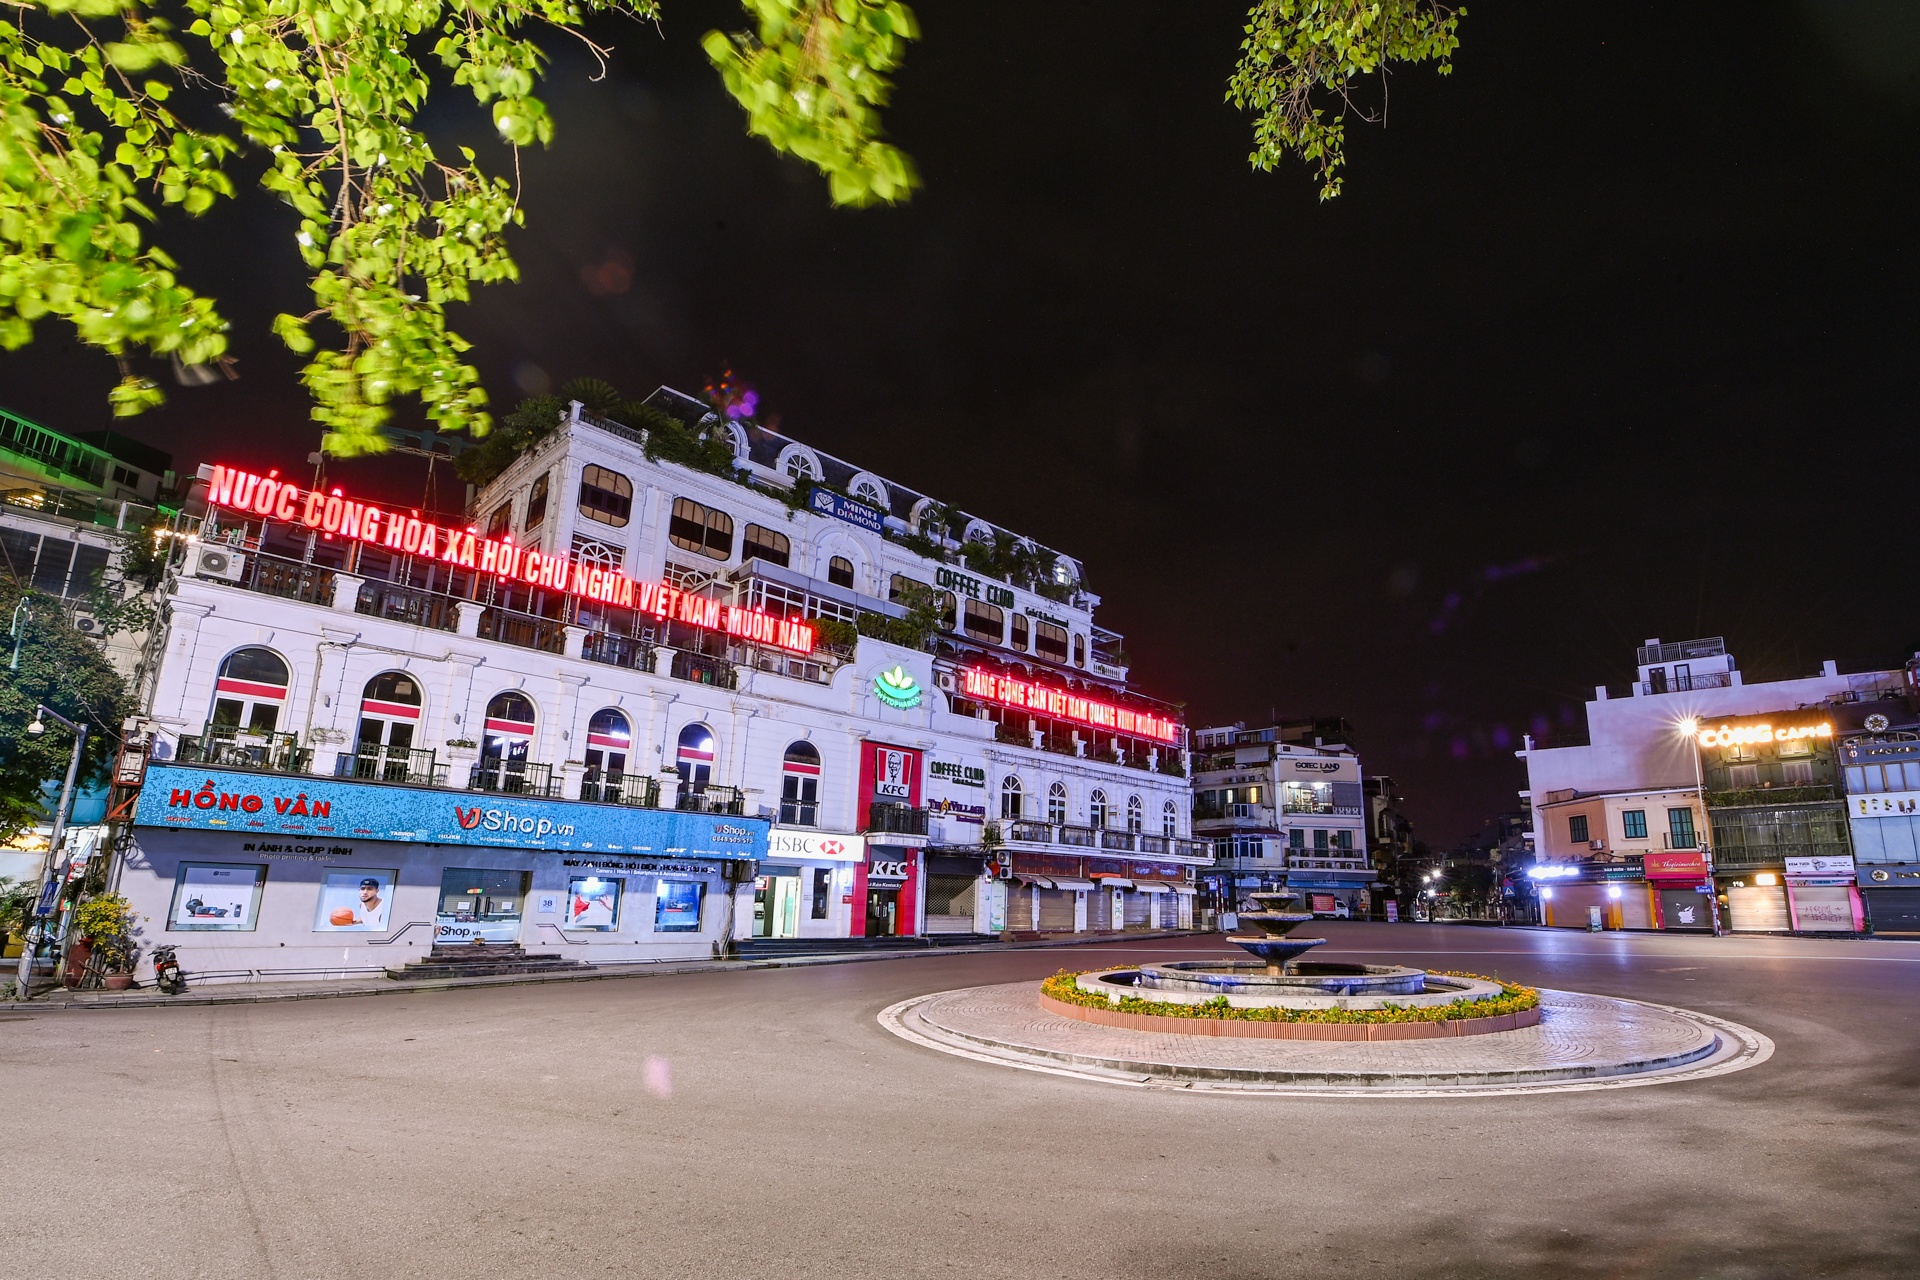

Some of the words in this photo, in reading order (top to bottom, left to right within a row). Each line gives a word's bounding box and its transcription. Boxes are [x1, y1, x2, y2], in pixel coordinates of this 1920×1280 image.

[837, 508, 881, 530] DIAMOND
[843, 501, 878, 520] MINH
[208, 464, 298, 521] NƯỚC
[303, 488, 380, 542] CỘNG
[384, 509, 437, 558] HÒA
[442, 527, 476, 568] XÃ
[480, 536, 520, 583] HỘI
[525, 550, 568, 591] CHỦ
[573, 568, 633, 608] NGHĨA
[639, 580, 678, 621] VIỆT
[679, 594, 720, 630] NAM
[727, 606, 775, 643] MUÔN
[778, 617, 814, 653] NĂM
[936, 567, 981, 599] COFFEE
[987, 585, 1014, 609] CLUB
[966, 666, 995, 698] ĐẢNG
[998, 675, 1024, 706] CỘNG
[1027, 682, 1046, 710] SẢN
[1048, 688, 1067, 718] VIỆT
[1068, 697, 1087, 720] NAM
[1089, 702, 1115, 727] QUANG
[1117, 708, 1135, 732] VINH
[931, 761, 962, 777] COFFEE
[964, 766, 984, 781] CLUB
[1320, 762, 1340, 770] LAND
[168, 779, 264, 813] HỒNG
[274, 793, 332, 819] VÂN
[882, 784, 905, 795] KFC
[243, 843, 255, 851] IN
[258, 841, 283, 853] ẢNH
[285, 845, 293, 853] &
[295, 845, 325, 856] CHỤP
[327, 846, 353, 855] HÌNH
[769, 836, 814, 853] HSBC
[563, 858, 580, 867] MÁY
[871, 860, 908, 876] KFC
